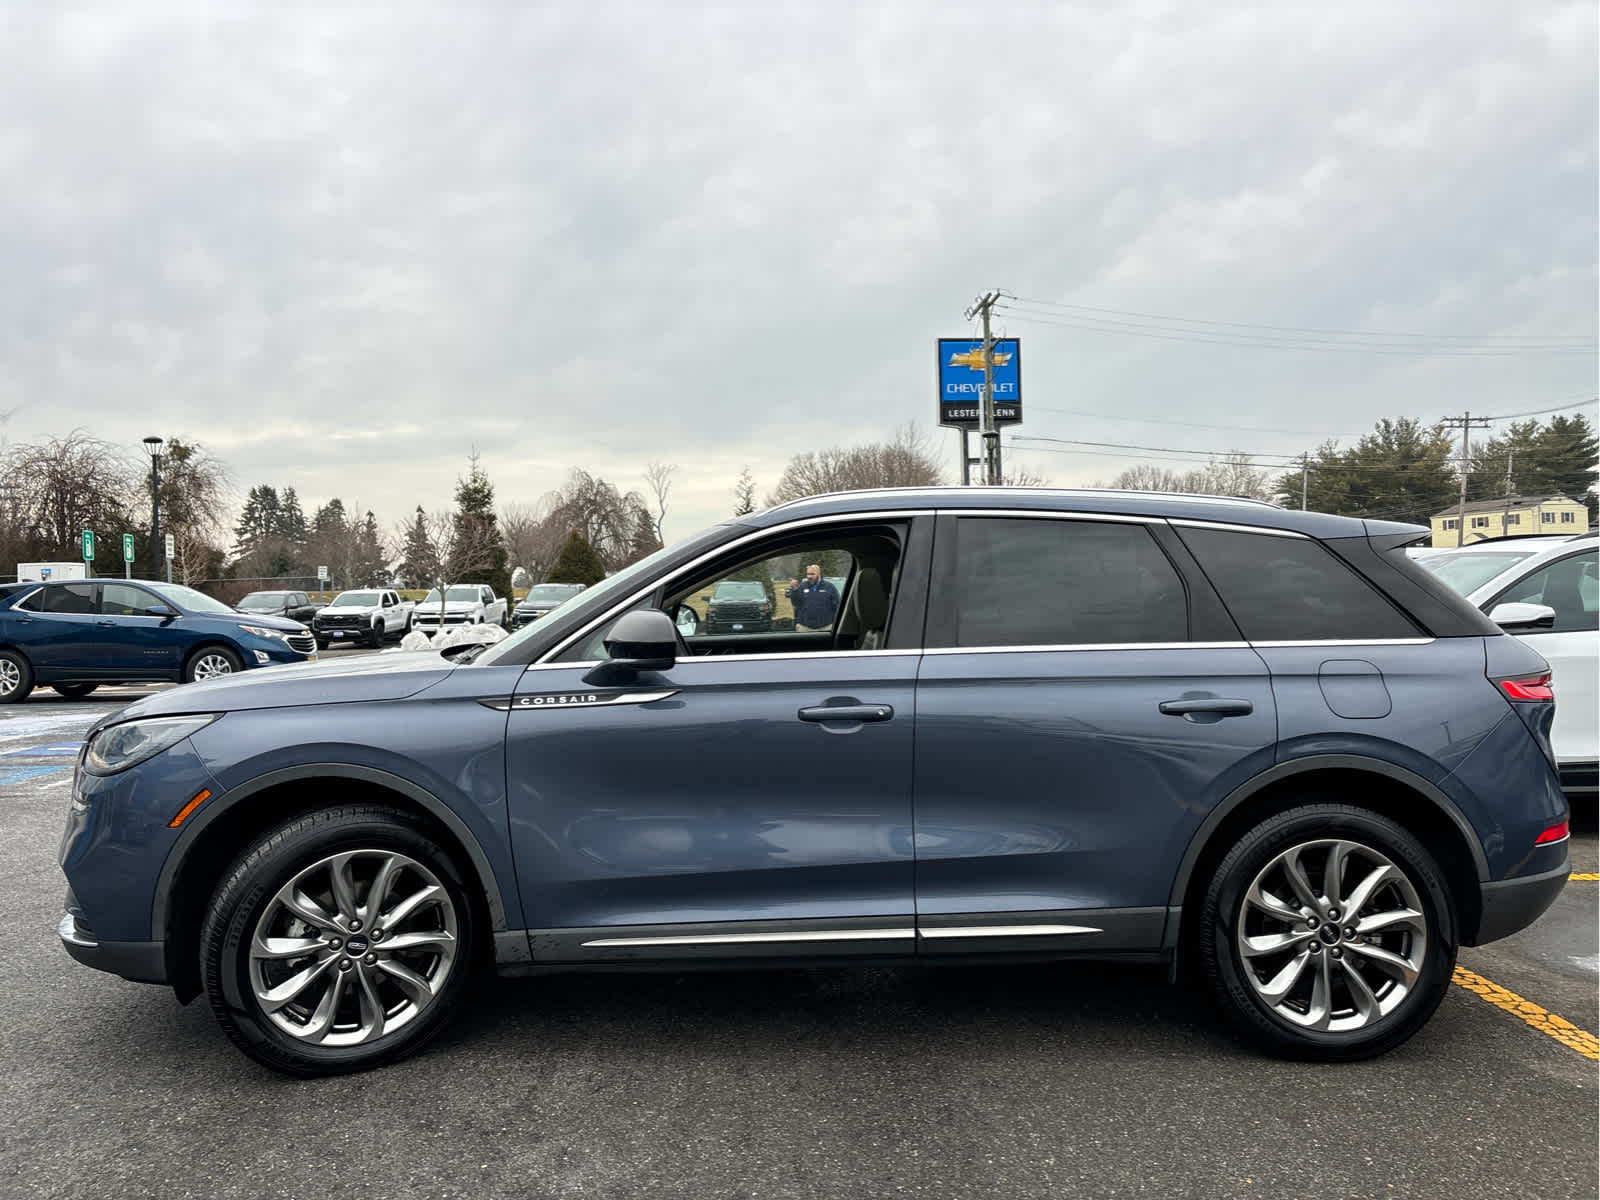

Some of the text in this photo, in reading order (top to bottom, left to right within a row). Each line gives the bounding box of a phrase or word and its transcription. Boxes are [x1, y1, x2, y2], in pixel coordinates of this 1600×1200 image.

[946, 383, 1014, 393] CHEVRLET
[985, 408, 1015, 417] LENN
[520, 695, 598, 705] CORSAIR
